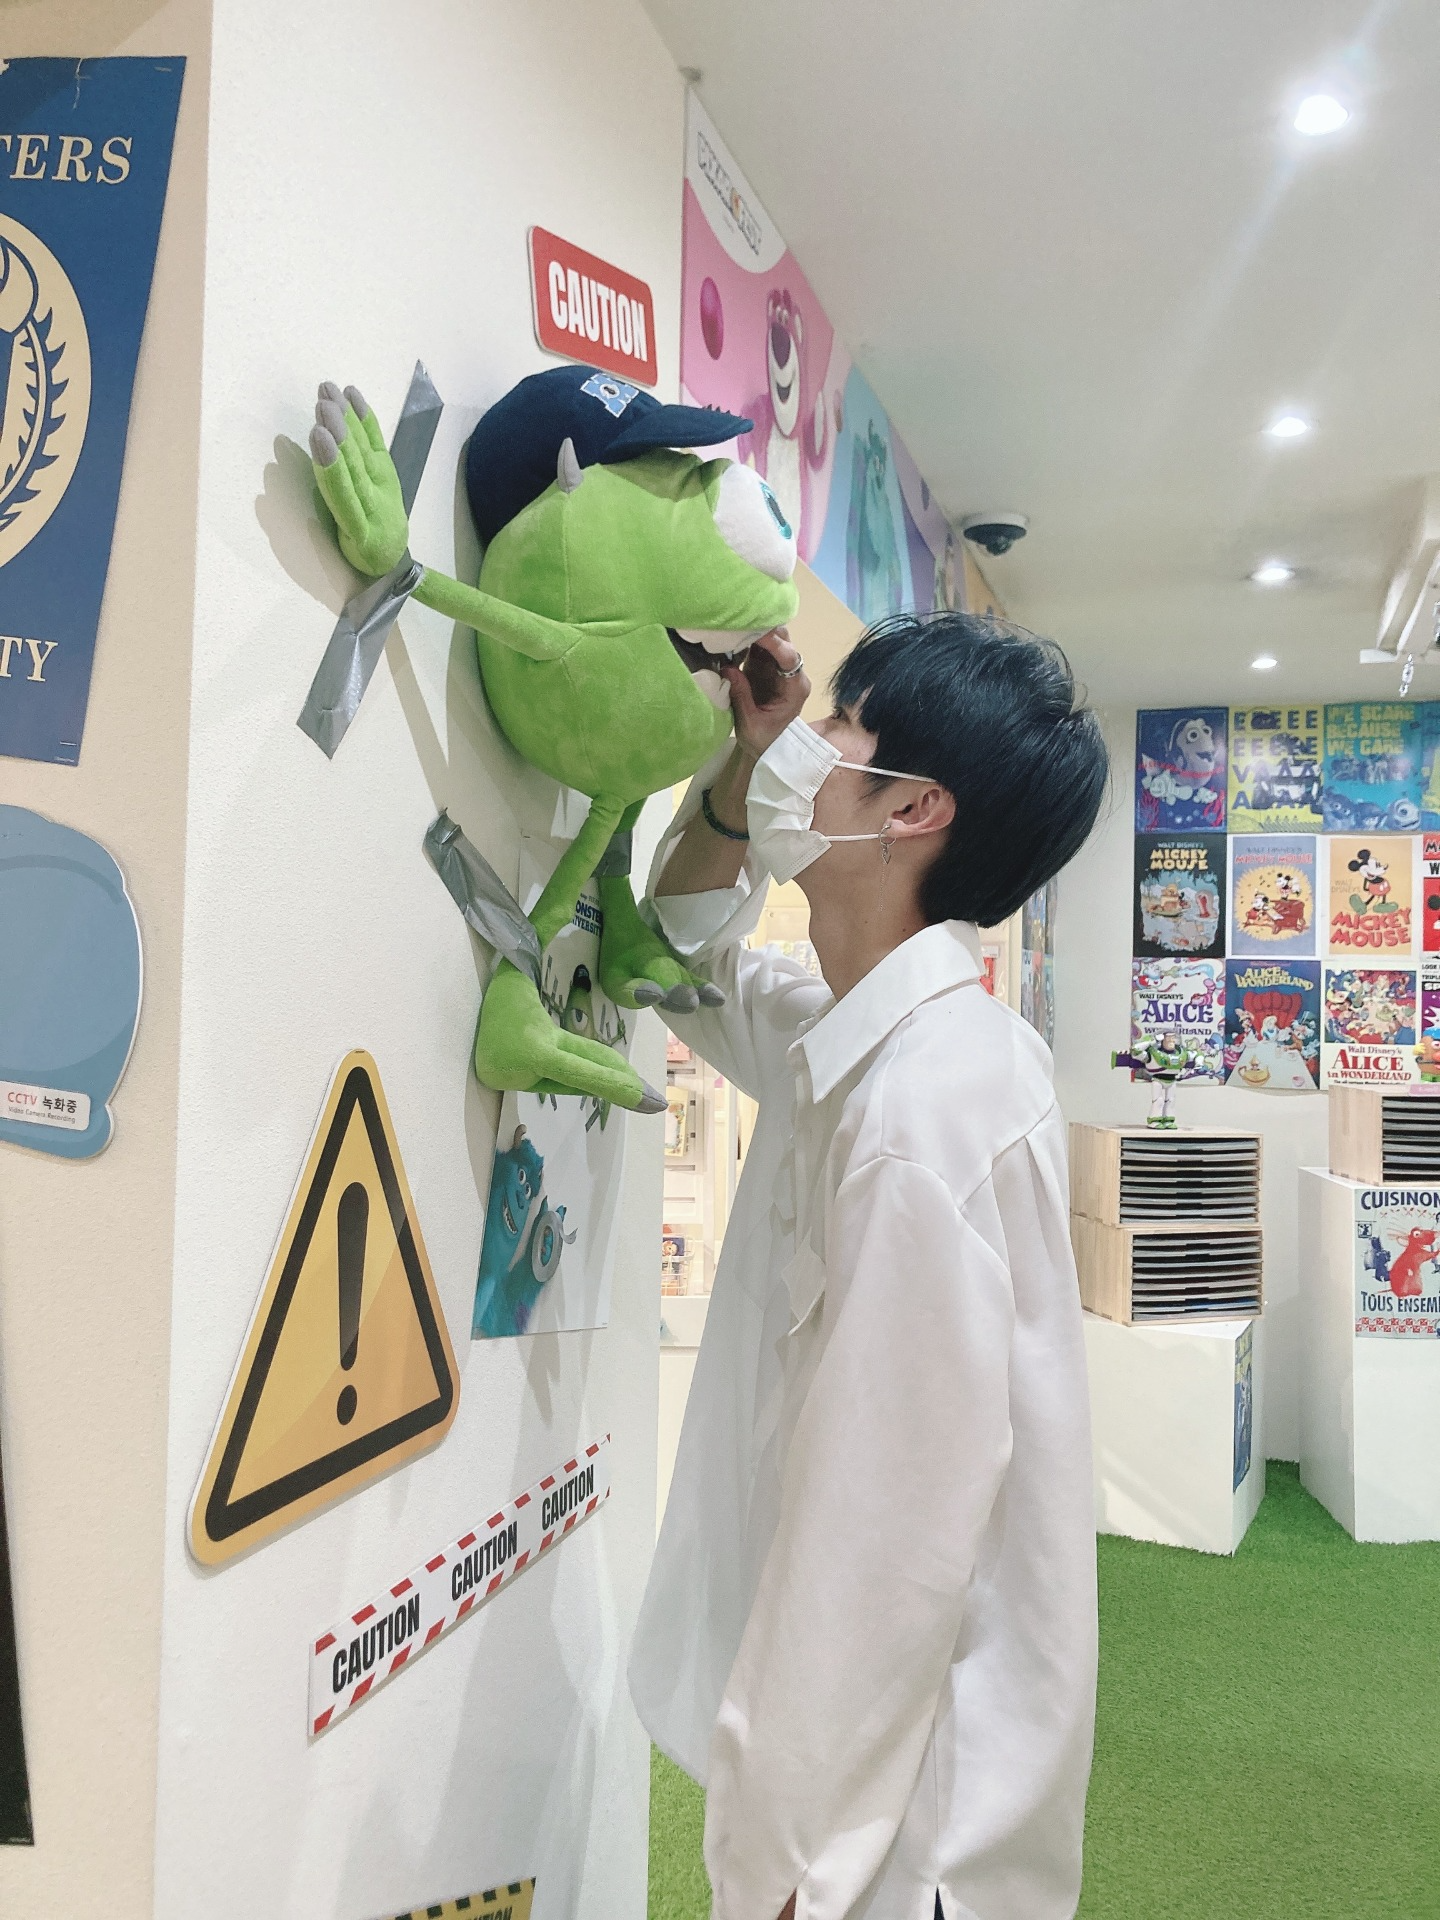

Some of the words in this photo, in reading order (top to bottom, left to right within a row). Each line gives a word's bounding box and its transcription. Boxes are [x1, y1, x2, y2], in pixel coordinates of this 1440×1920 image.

[548, 260, 648, 363] CAUTION
[0, 635, 58, 682] TY
[1150, 848, 1208, 860] MICKEY
[1425, 841, 1440, 852] M
[1150, 859, 1209, 871] MOUSE
[1331, 907, 1412, 931] MICKEY
[1330, 927, 1411, 948] MOUSE
[1234, 973, 1314, 991] WONDERLAND
[1244, 966, 1281, 979] ALICE
[1141, 1000, 1214, 1023] ALICE
[1332, 1049, 1404, 1071] ALICE
[1348, 1045, 1365, 1054] Walt
[1341, 1070, 1412, 1081] WONDERLAND
[7, 1092, 38, 1105] CCTV
[42, 1096, 77, 1114] 녹화중
[9, 1106, 24, 1115] Video
[25, 1109, 46, 1118] Camera
[47, 1112, 76, 1125] Recording
[1360, 1291, 1393, 1312] TOUS
[1397, 1297, 1440, 1313] ENSEM
[332, 1593, 420, 1694] CAUTION
[451, 1521, 518, 1601] CAUTION
[541, 1464, 595, 1531] CAUTION
